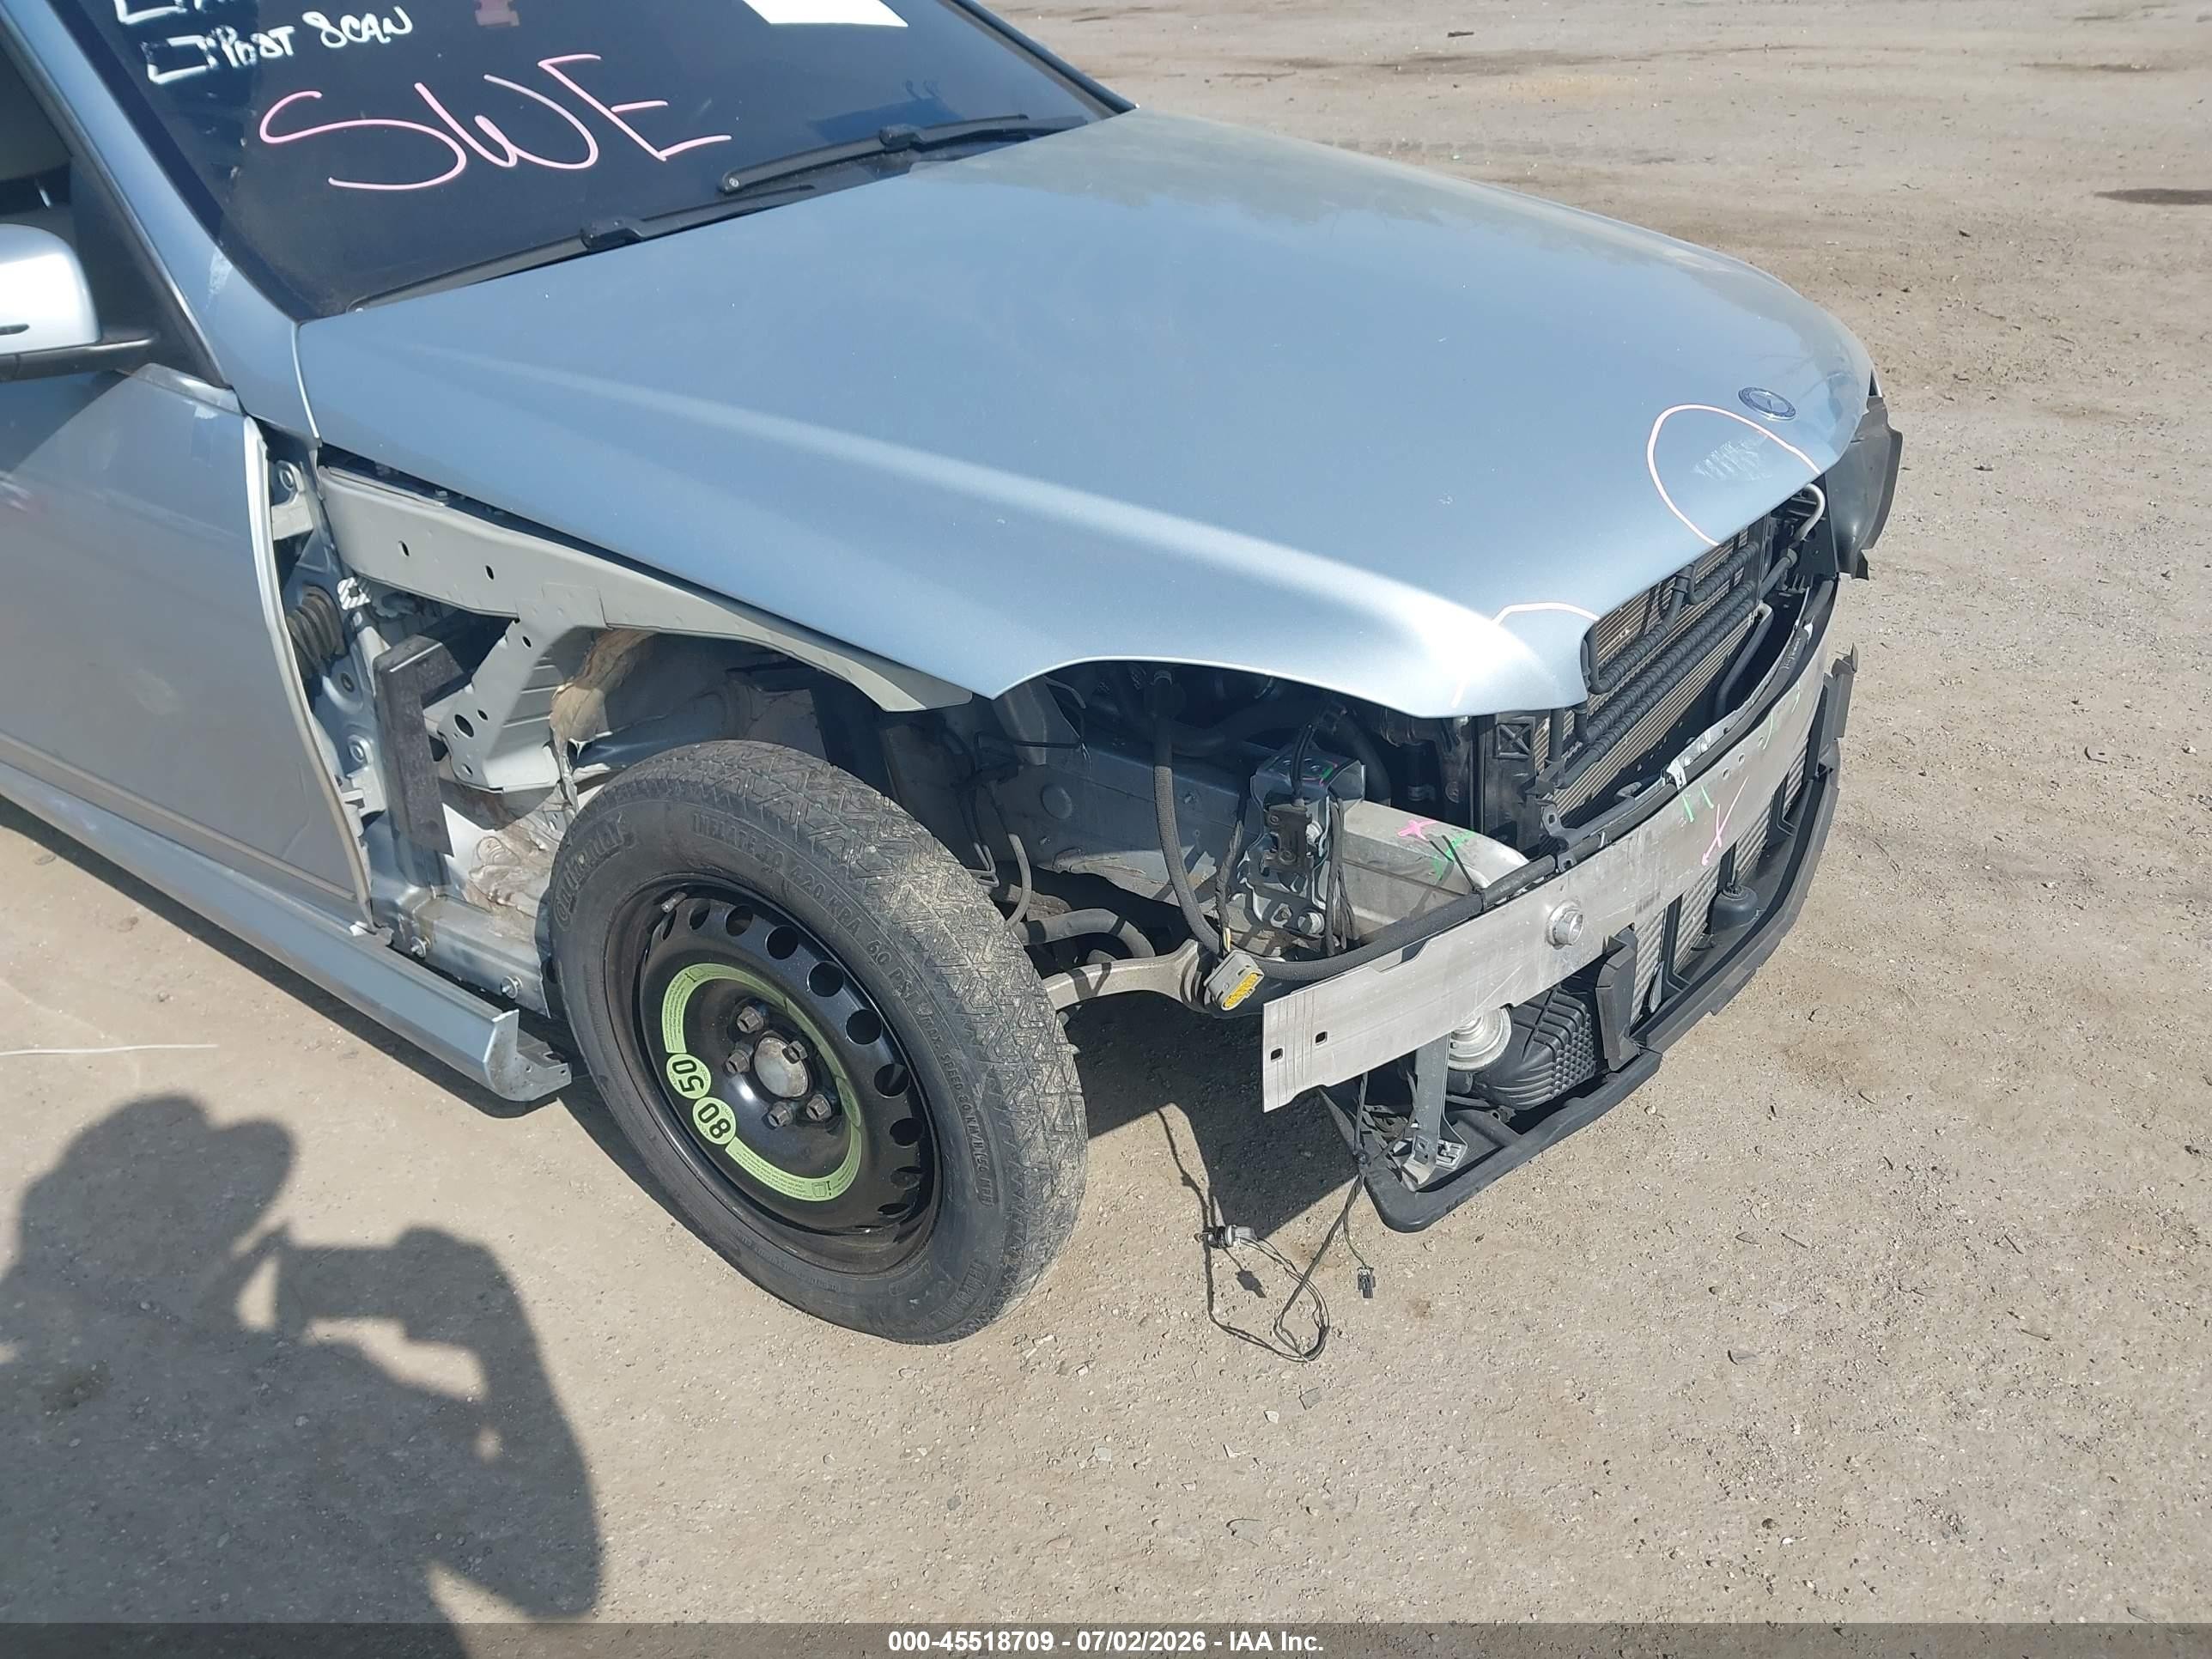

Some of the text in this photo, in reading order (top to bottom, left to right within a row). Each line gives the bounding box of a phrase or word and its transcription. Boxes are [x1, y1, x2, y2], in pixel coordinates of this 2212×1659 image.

[302, 6, 412, 48] SCAN
[259, 53, 732, 191] SWE
[790, 866, 825, 898] 420
[866, 940, 891, 964] 60
[888, 967, 919, 1004] PSI
[941, 1053, 963, 1091] SPEED
[965, 1115, 983, 1150] KM/H
[672, 1060, 704, 1092] 50
[697, 1103, 731, 1139] 80
